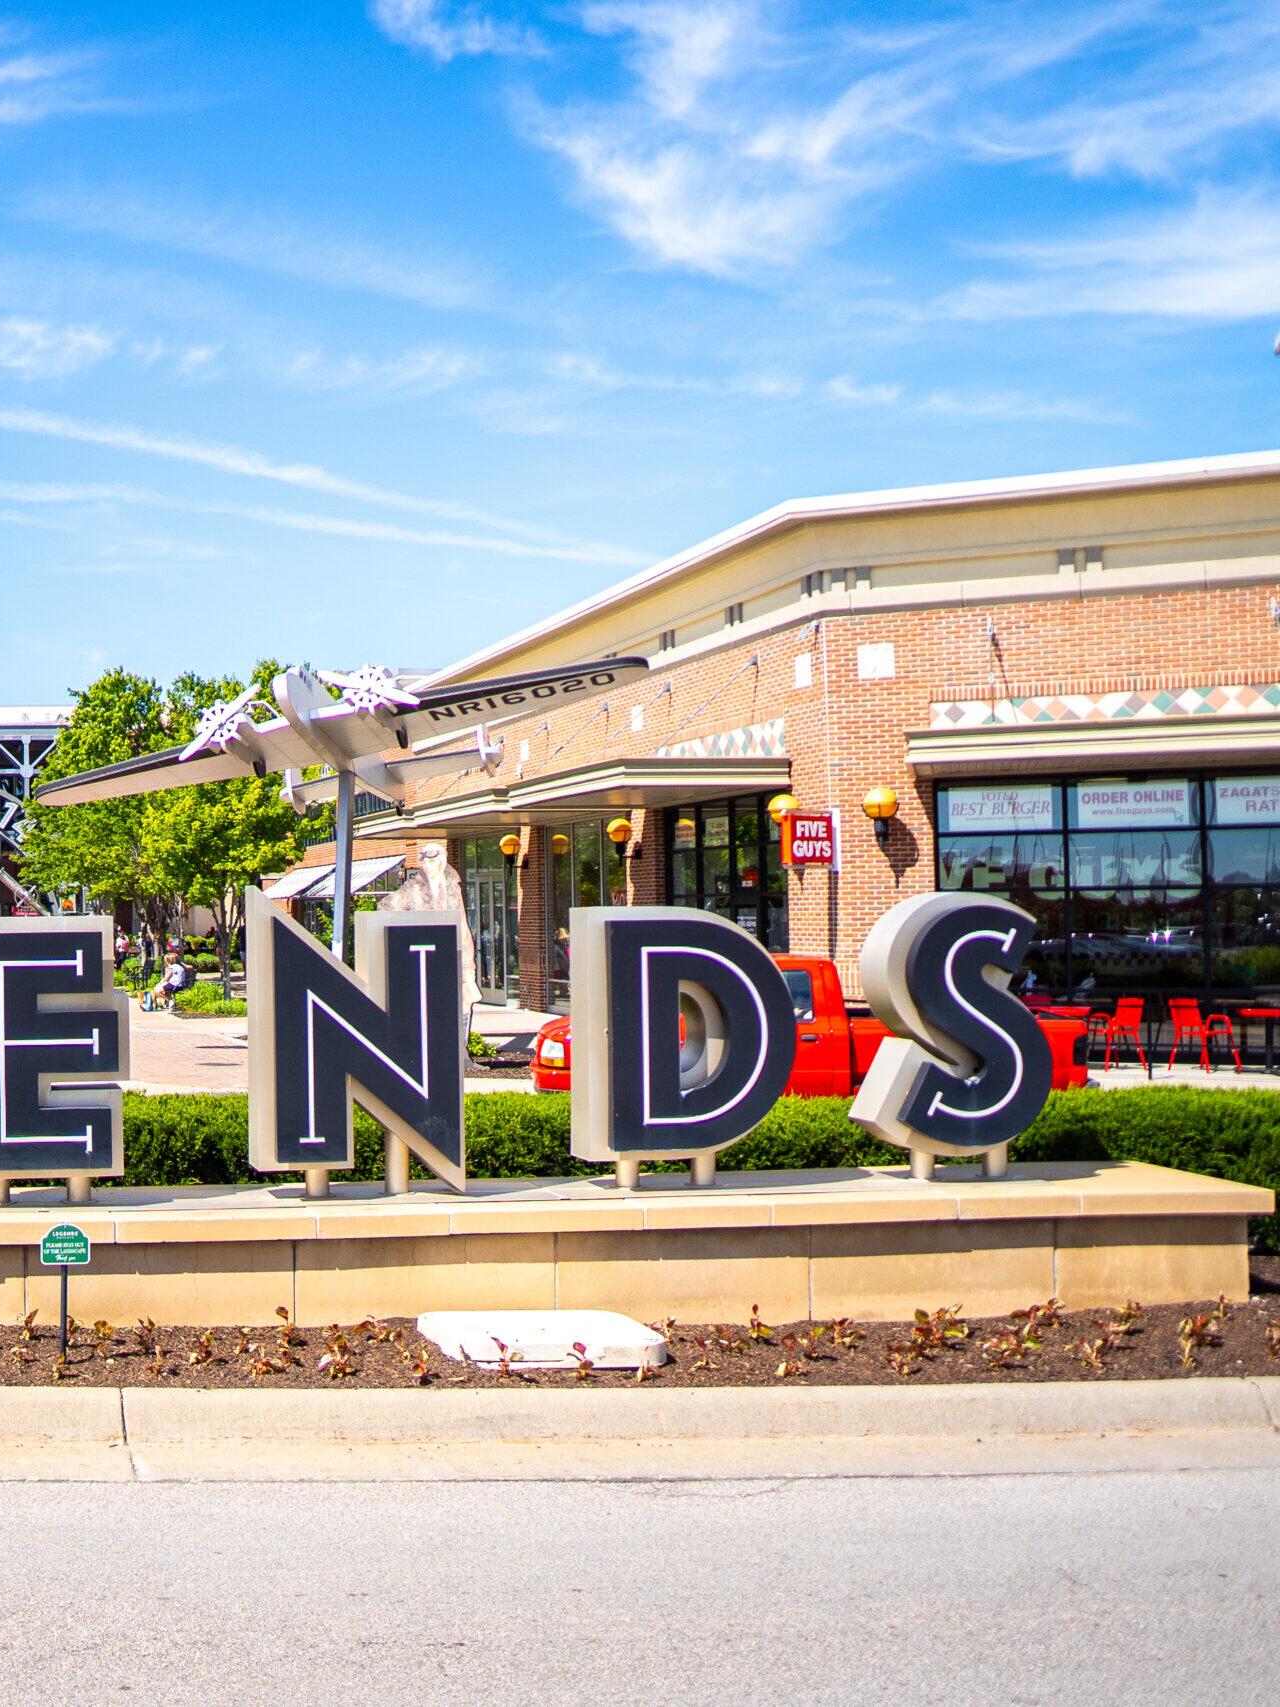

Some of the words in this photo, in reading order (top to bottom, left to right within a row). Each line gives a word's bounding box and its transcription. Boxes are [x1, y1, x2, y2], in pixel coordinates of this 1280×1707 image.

[981, 791, 1018, 802] VOTED
[1081, 790, 1129, 805] ORDER
[1133, 789, 1185, 804] ONLINE
[951, 802, 987, 816] BEST
[992, 800, 1051, 816] BURGER
[795, 820, 828, 838] FIVE
[792, 840, 832, 858] GUYS
